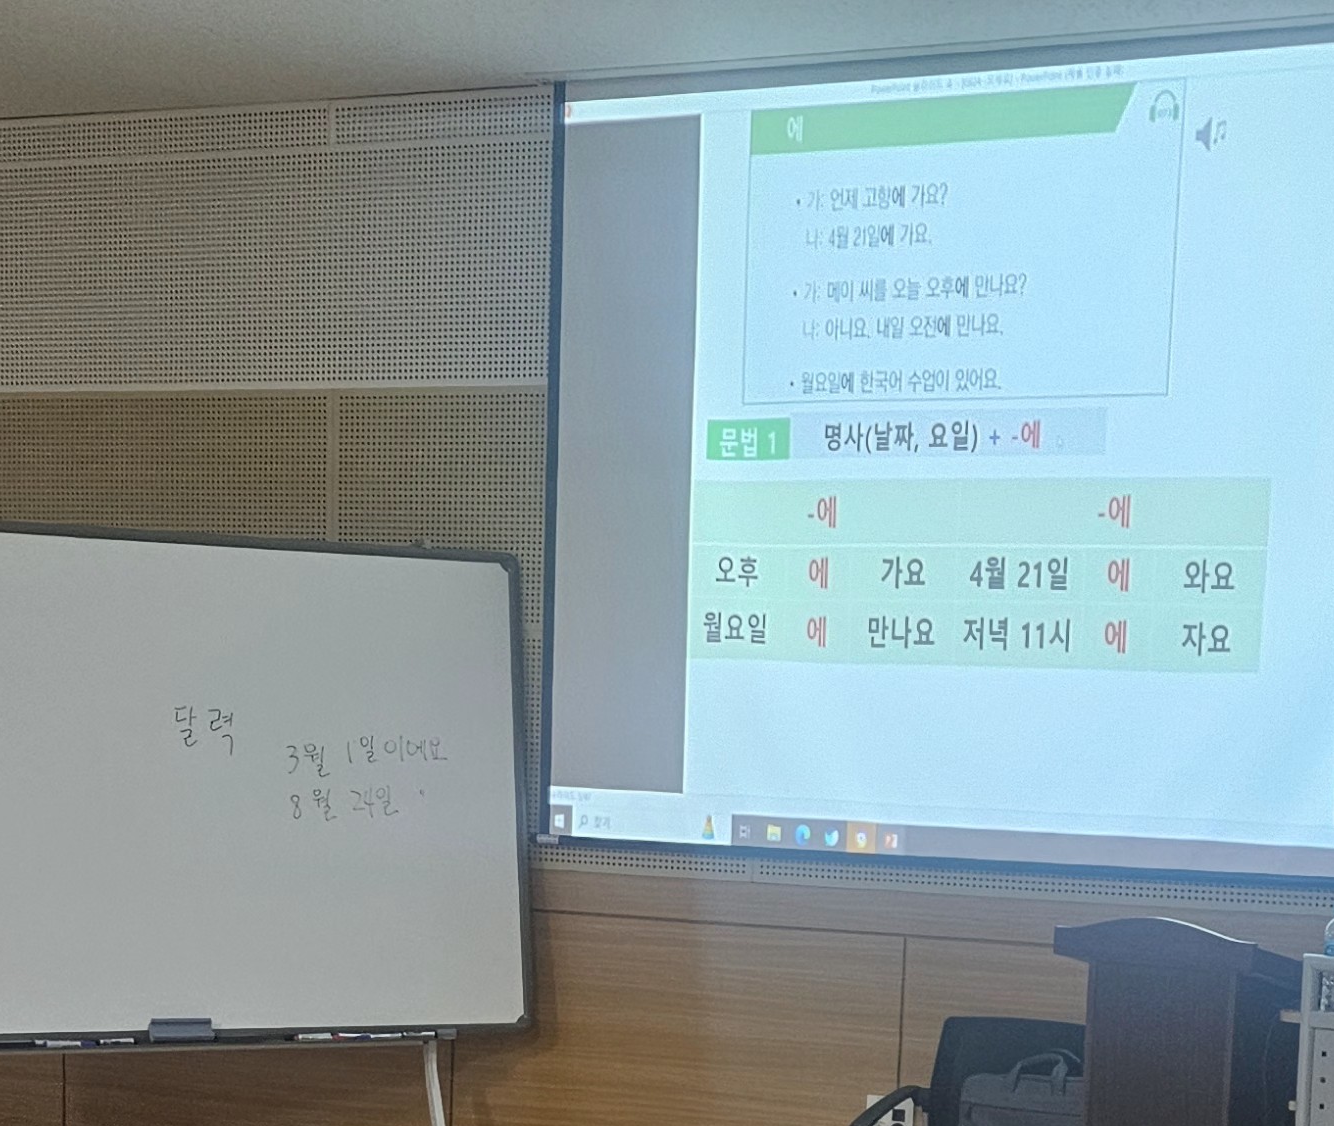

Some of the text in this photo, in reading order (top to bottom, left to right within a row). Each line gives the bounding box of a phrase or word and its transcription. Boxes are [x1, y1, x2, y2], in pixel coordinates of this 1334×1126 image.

[787, 115, 804, 141] 에
[806, 183, 949, 211] 가: 언제 고향에 가요?
[805, 222, 933, 249] 나: 4월 21일에 가요.
[804, 272, 1027, 303] 가: 메이 씨를 오늘 오후에 만나요?
[802, 321, 819, 341] 나:
[876, 315, 905, 339] 내일
[909, 314, 951, 338] 오전에
[956, 312, 1004, 337] 만나요.
[801, 367, 1002, 394] 월요일에 한국어 수업이 있어요.
[719, 427, 776, 458] 문법 1
[825, 420, 1041, 454] 명사(날짜, 요일) + -에
[807, 496, 837, 528] -에
[1097, 494, 1132, 529] -에
[715, 556, 926, 589] 오후 에 가요
[969, 556, 1235, 594] 4월 21일 에 와요
[703, 611, 935, 649] 월요일 에 만나요
[963, 617, 1231, 657] 저녁 11시 에 자요
[285, 743, 330, 777] 3월
[290, 788, 337, 821] 8월
